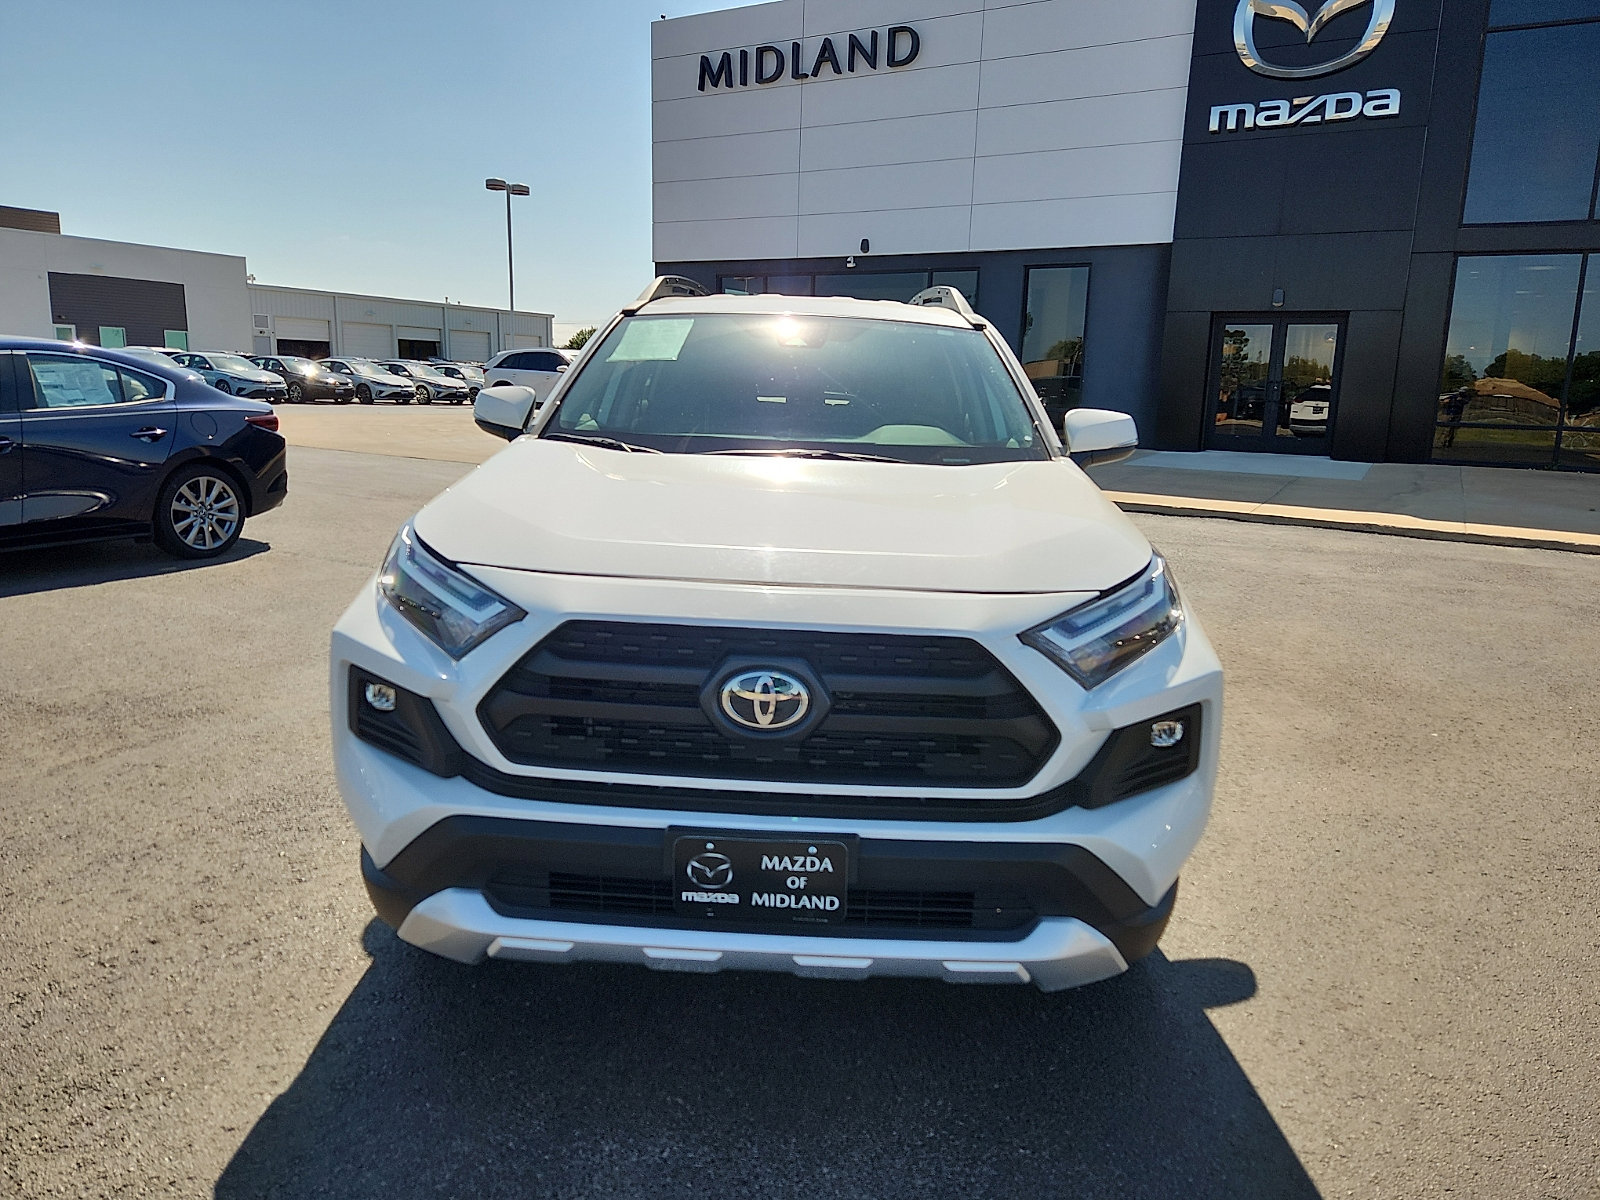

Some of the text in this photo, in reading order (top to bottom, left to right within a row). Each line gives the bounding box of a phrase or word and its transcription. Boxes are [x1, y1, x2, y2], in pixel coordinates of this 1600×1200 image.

[697, 25, 920, 92] MIDLAND
[761, 855, 833, 873] MAZDA
[786, 876, 808, 889] OF
[751, 892, 840, 911] MIDLAND
